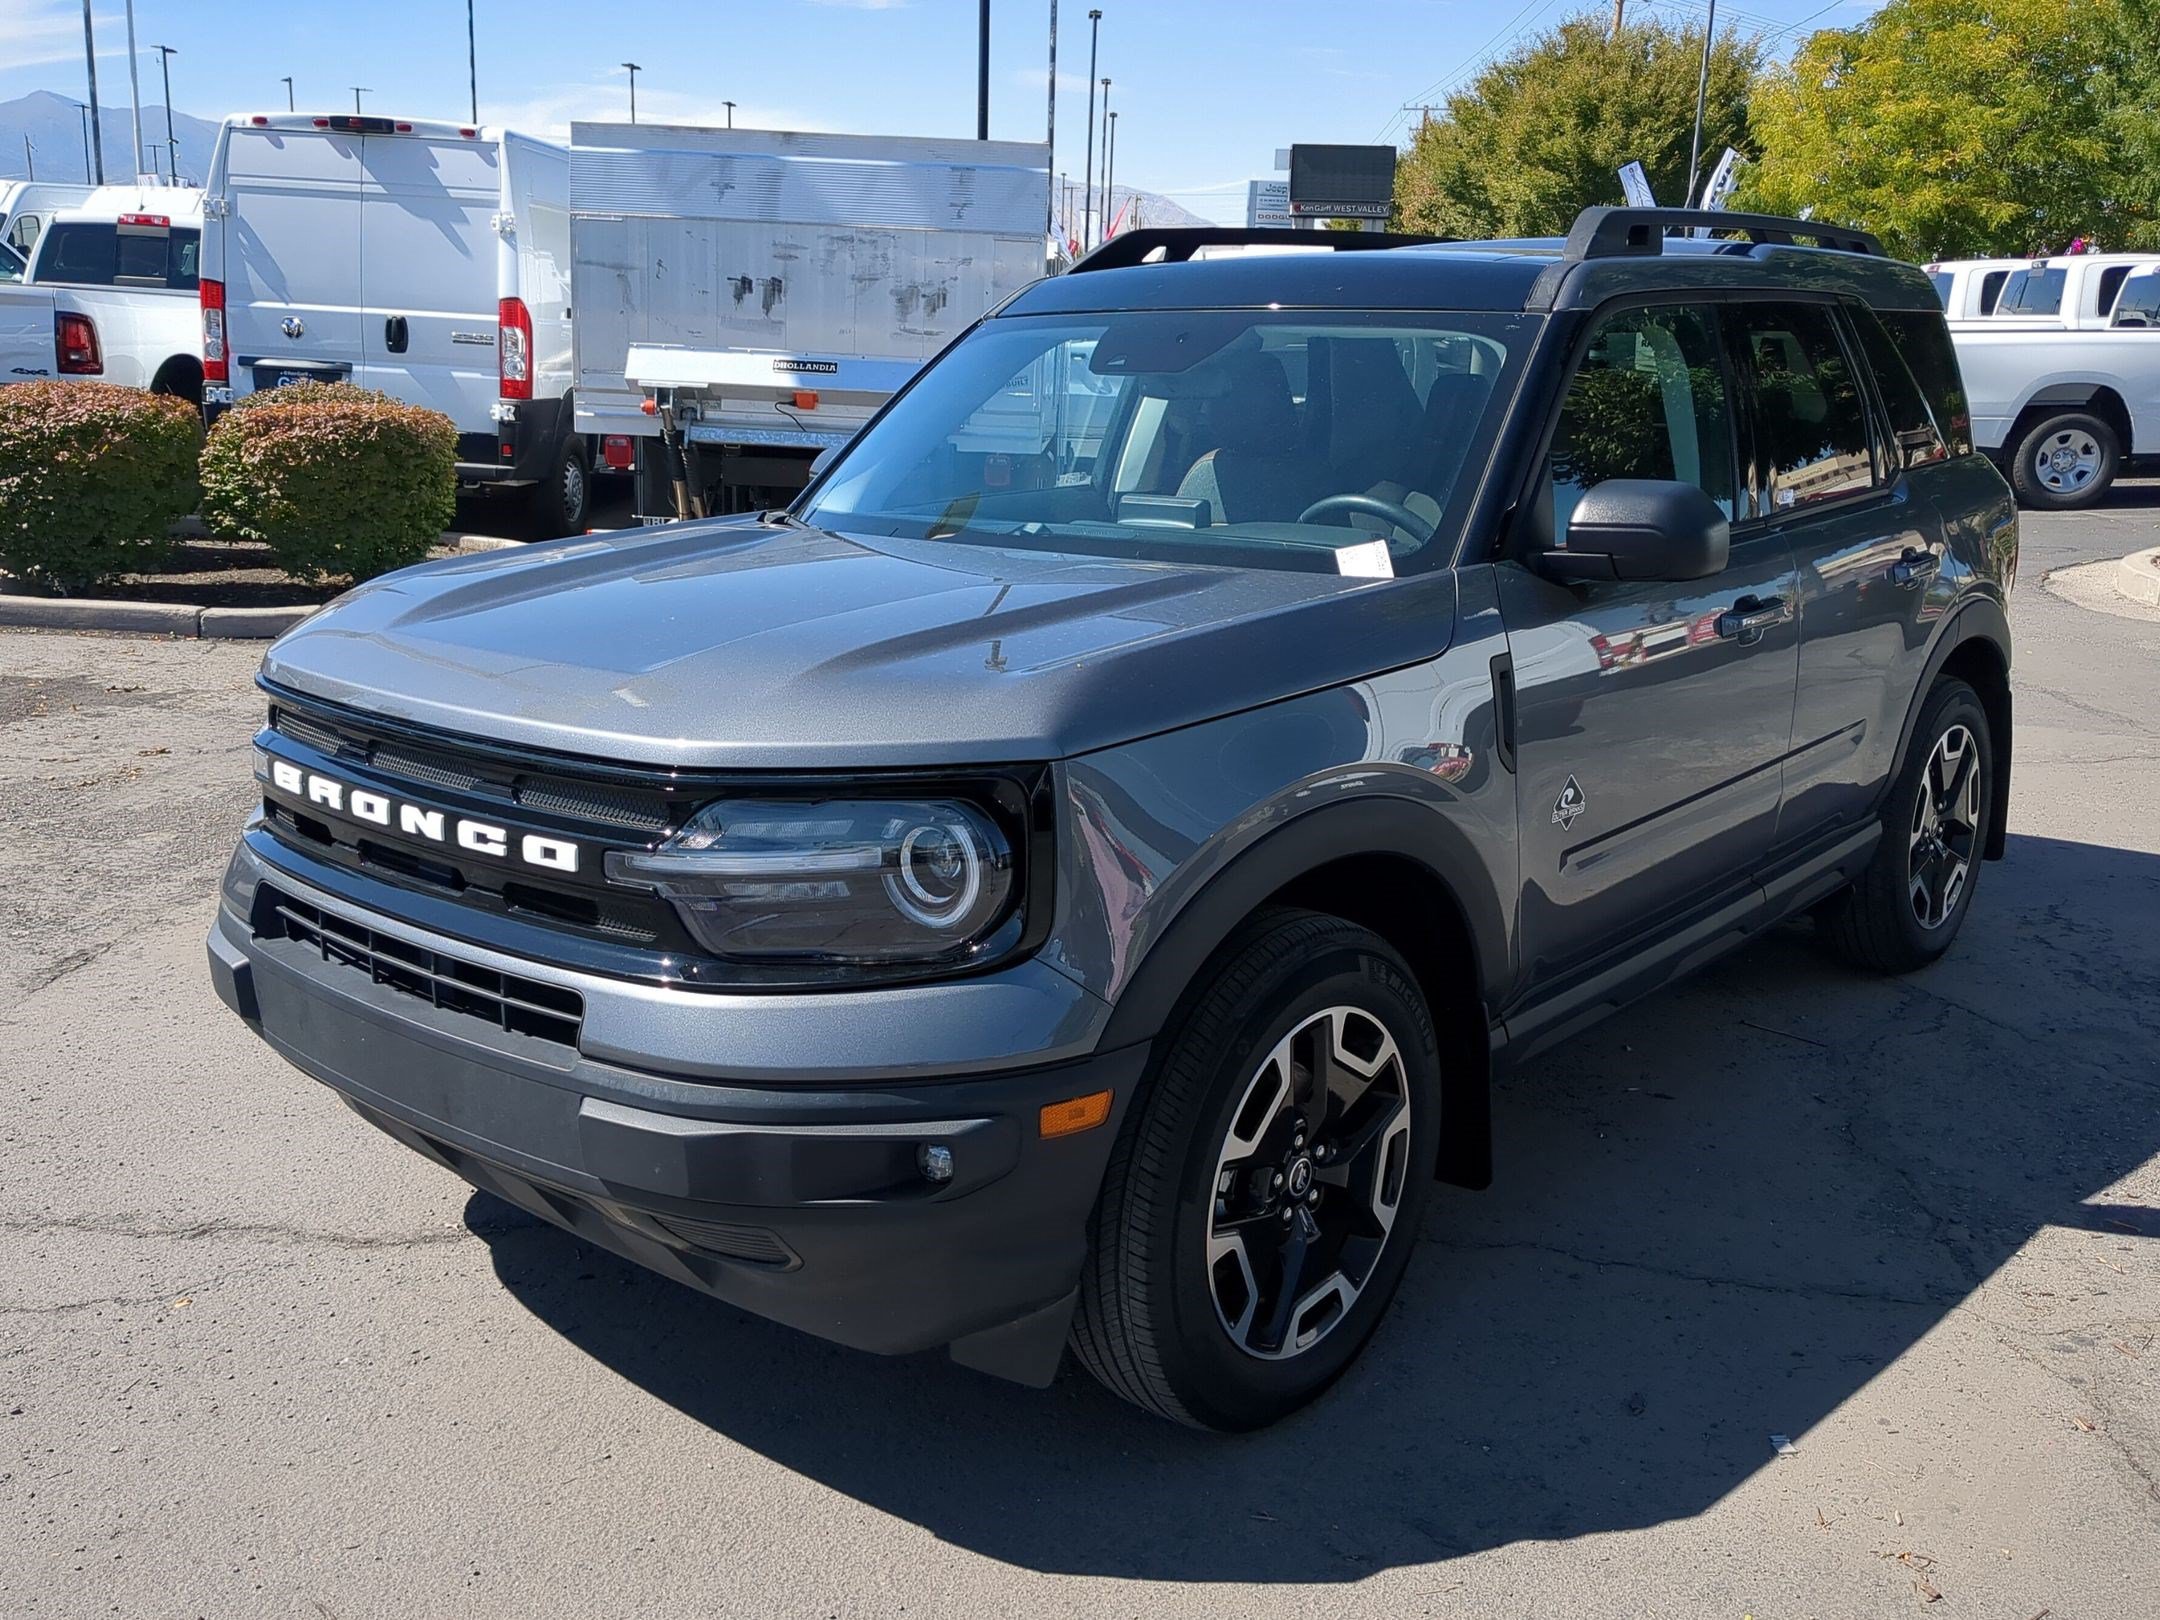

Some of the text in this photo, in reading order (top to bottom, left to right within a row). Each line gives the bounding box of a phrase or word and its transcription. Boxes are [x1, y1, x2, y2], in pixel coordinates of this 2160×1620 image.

[1264, 183, 1288, 194] Jeep
[1333, 204, 1356, 212] WEST
[1357, 204, 1388, 213] VALLEY
[774, 361, 836, 372] DHOLLANDIA
[273, 760, 579, 872] BRONCO
